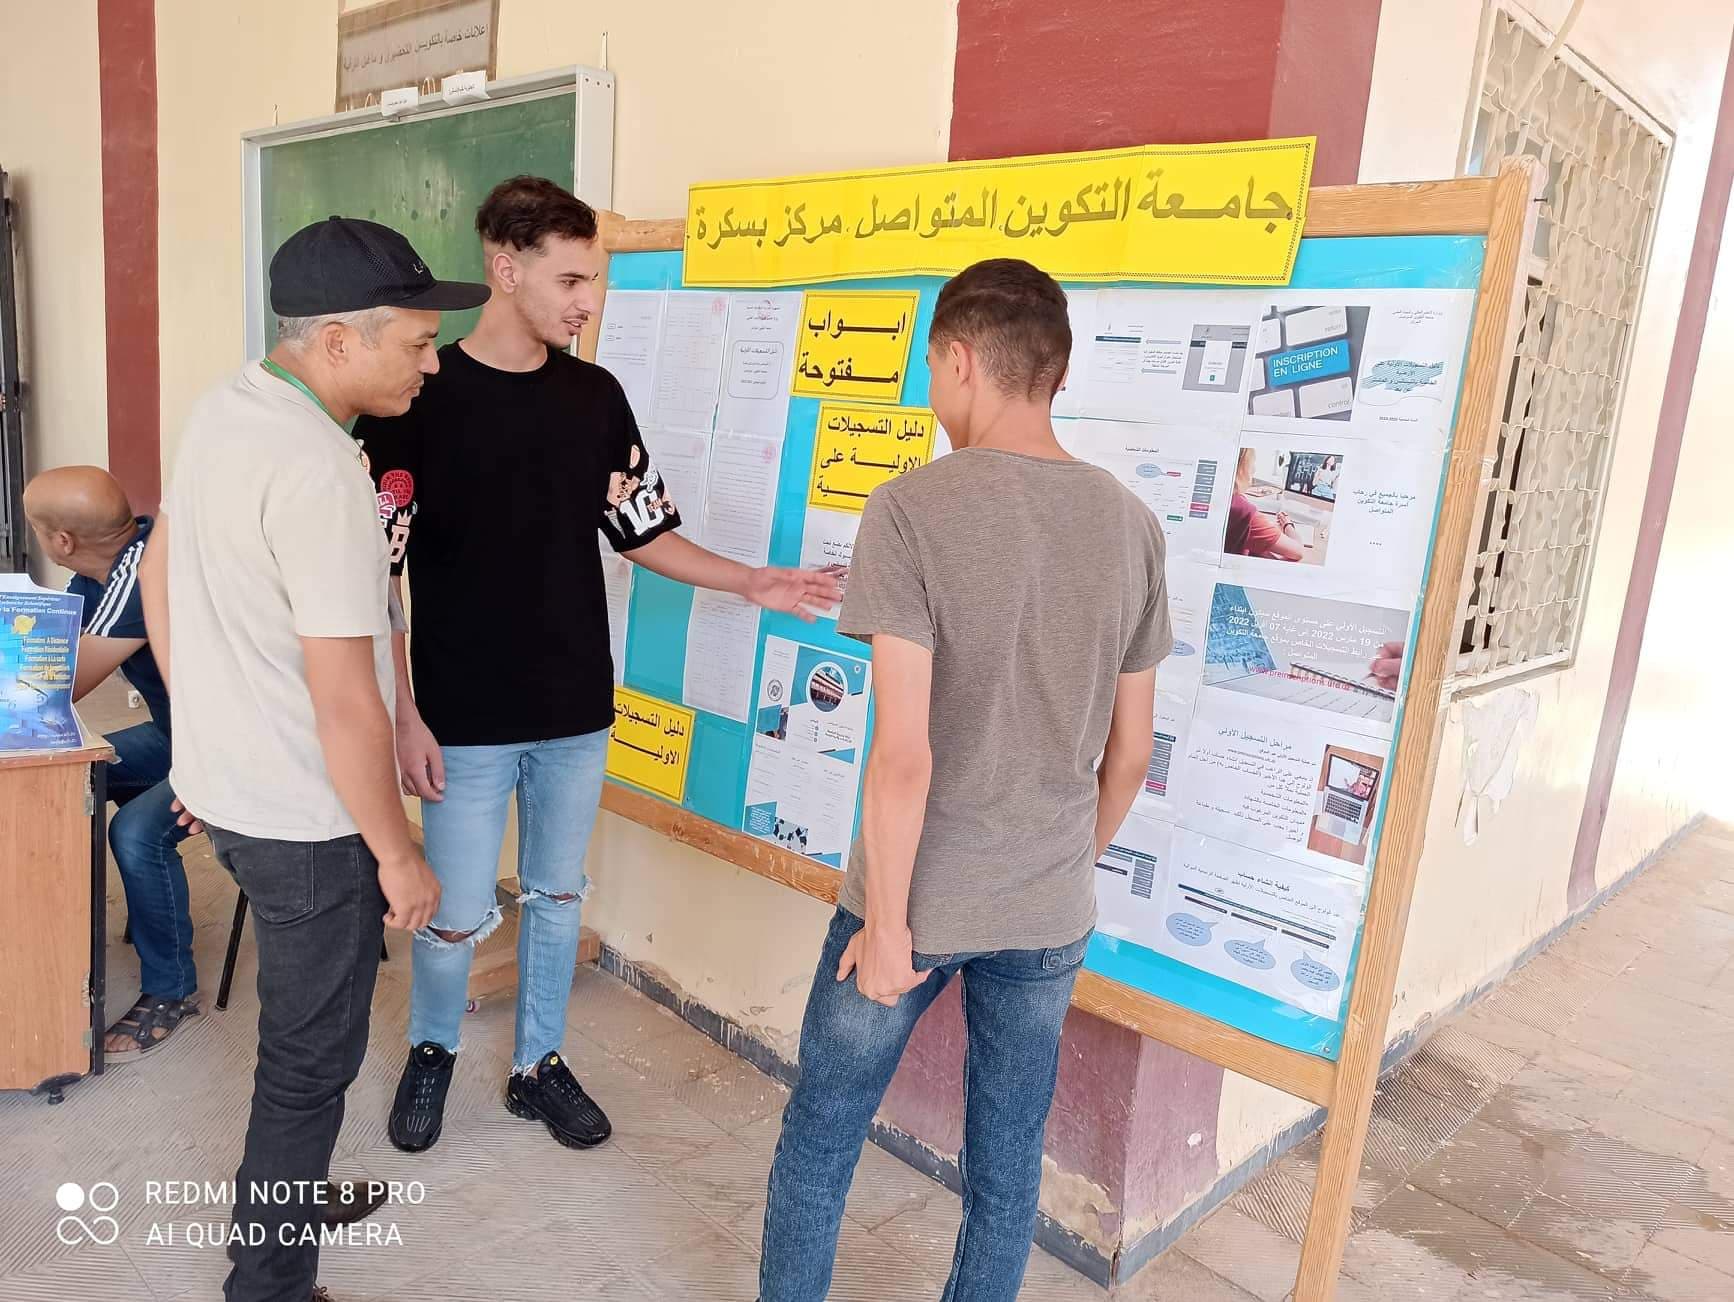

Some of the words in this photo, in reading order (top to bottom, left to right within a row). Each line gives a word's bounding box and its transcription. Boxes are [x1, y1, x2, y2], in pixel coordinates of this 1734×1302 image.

[855, 187, 998, 239] المتواصل
[1004, 175, 1131, 238] التكوين
[695, 205, 769, 249] بسكرة
[773, 200, 843, 247] مركز
[1273, 346, 1338, 368] INSCRIPTION
[1274, 367, 1288, 378] EN
[1292, 360, 1323, 374] LIGNE
[827, 415, 892, 438] التسجيلات
[896, 419, 925, 442] دليل
[820, 447, 845, 469] على
[12, 606, 46, 615] Formation
[47, 607, 77, 616] Continue
[1228, 615, 1250, 626] 2022
[1269, 622, 1281, 632] 07
[1311, 629, 1334, 641] 2022
[1360, 637, 1371, 647] 19
[663, 718, 685, 737] دليل
